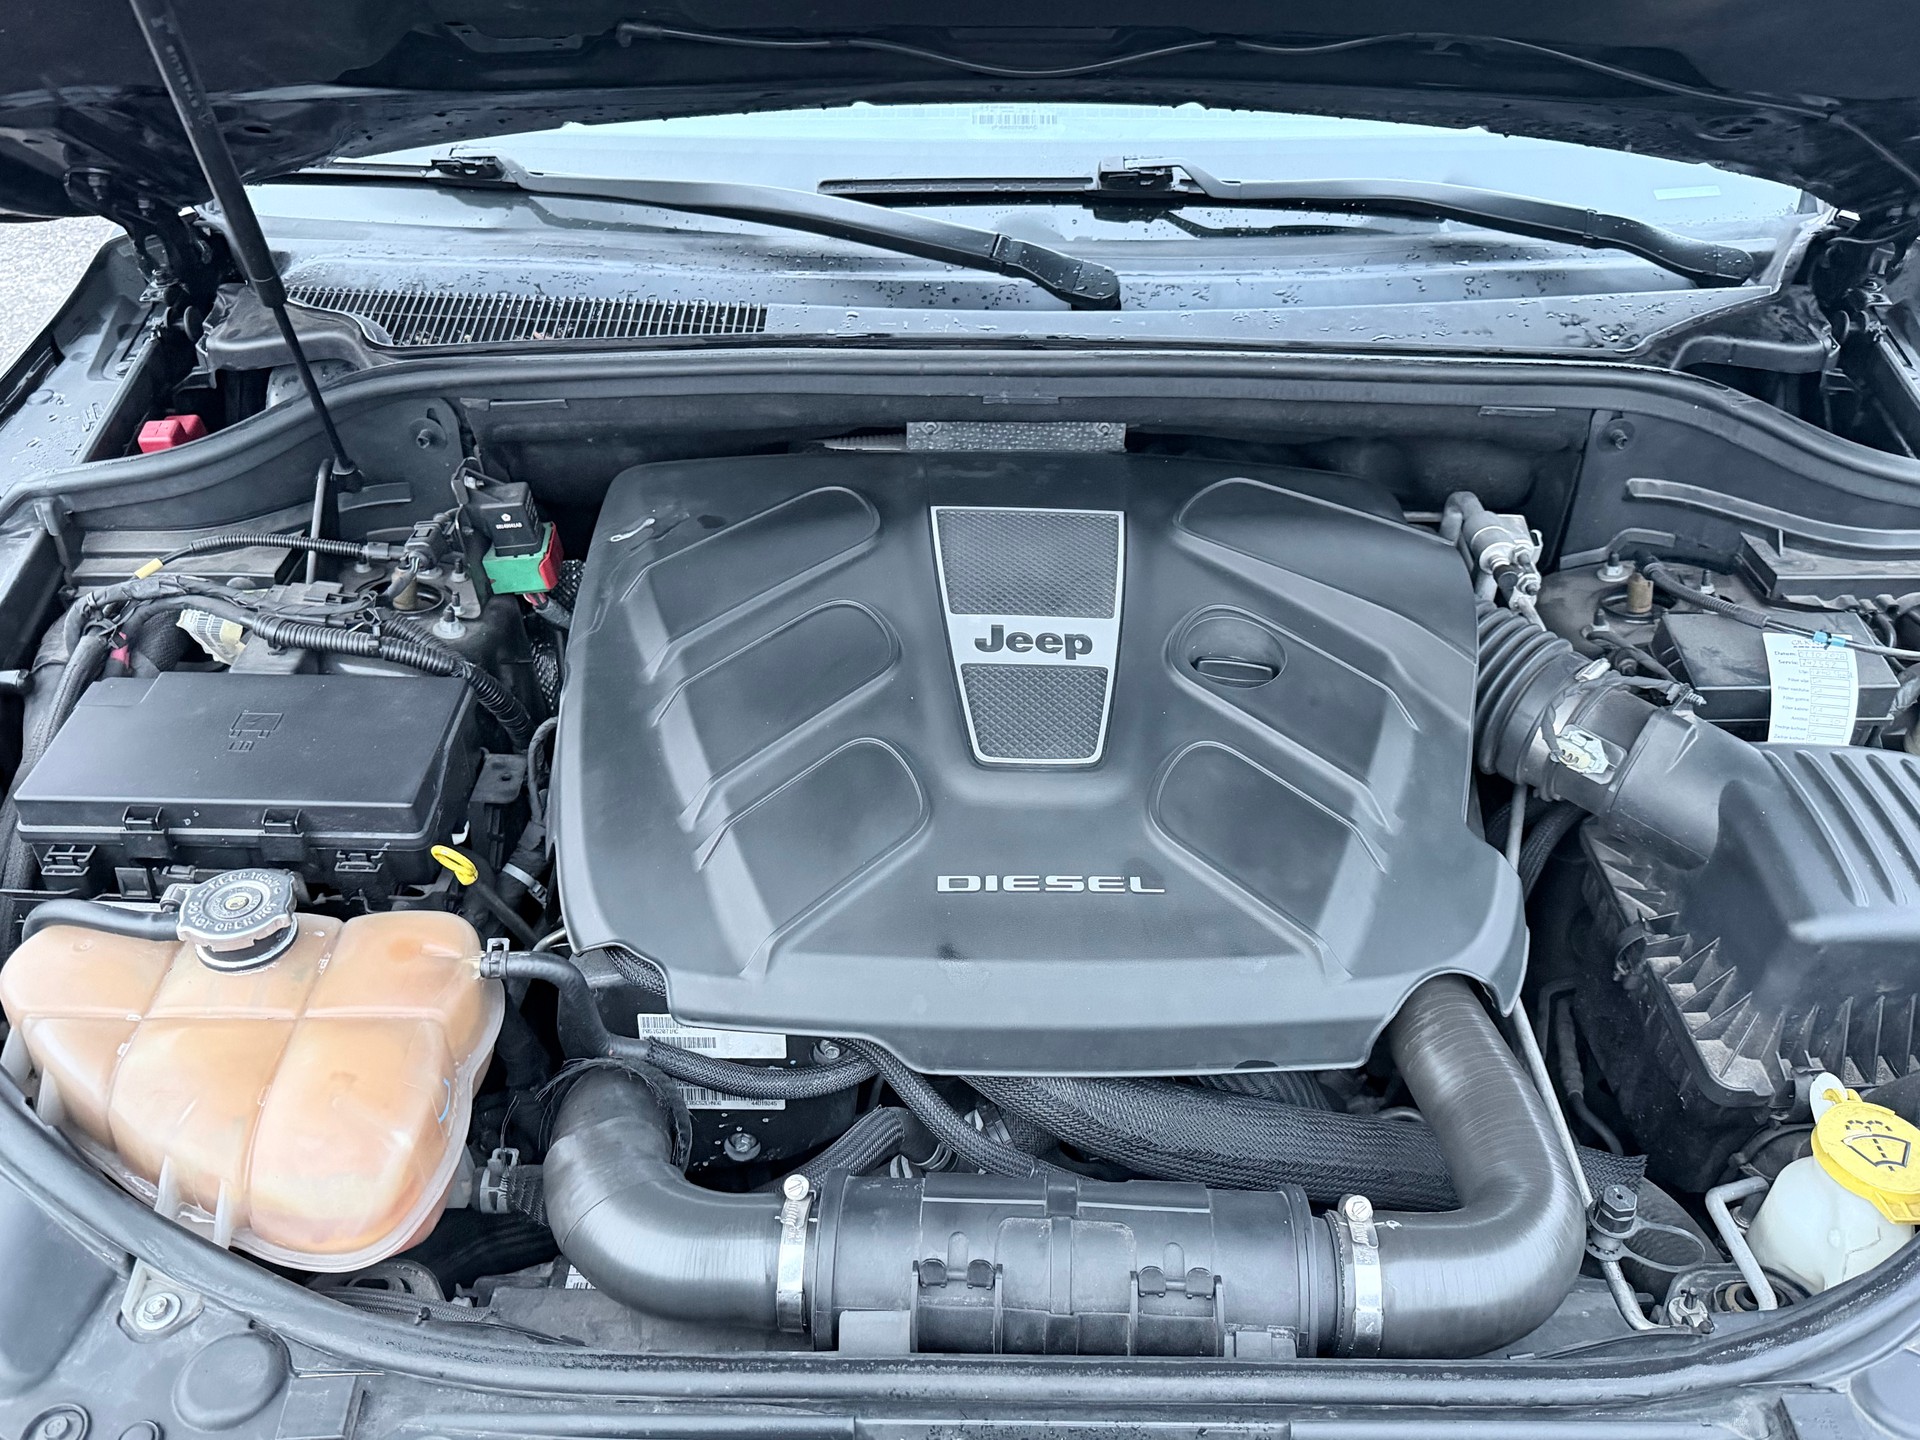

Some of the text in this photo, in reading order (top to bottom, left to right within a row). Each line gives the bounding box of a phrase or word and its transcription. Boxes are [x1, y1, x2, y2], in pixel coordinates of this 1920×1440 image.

[974, 624, 1093, 661] Jeep
[208, 871, 248, 889] KEEP
[936, 875, 1166, 893] DIESEL
[187, 901, 201, 914] DO
[254, 902, 278, 921] HOT
[190, 914, 214, 930] NOT
[214, 918, 254, 932] OPEN
